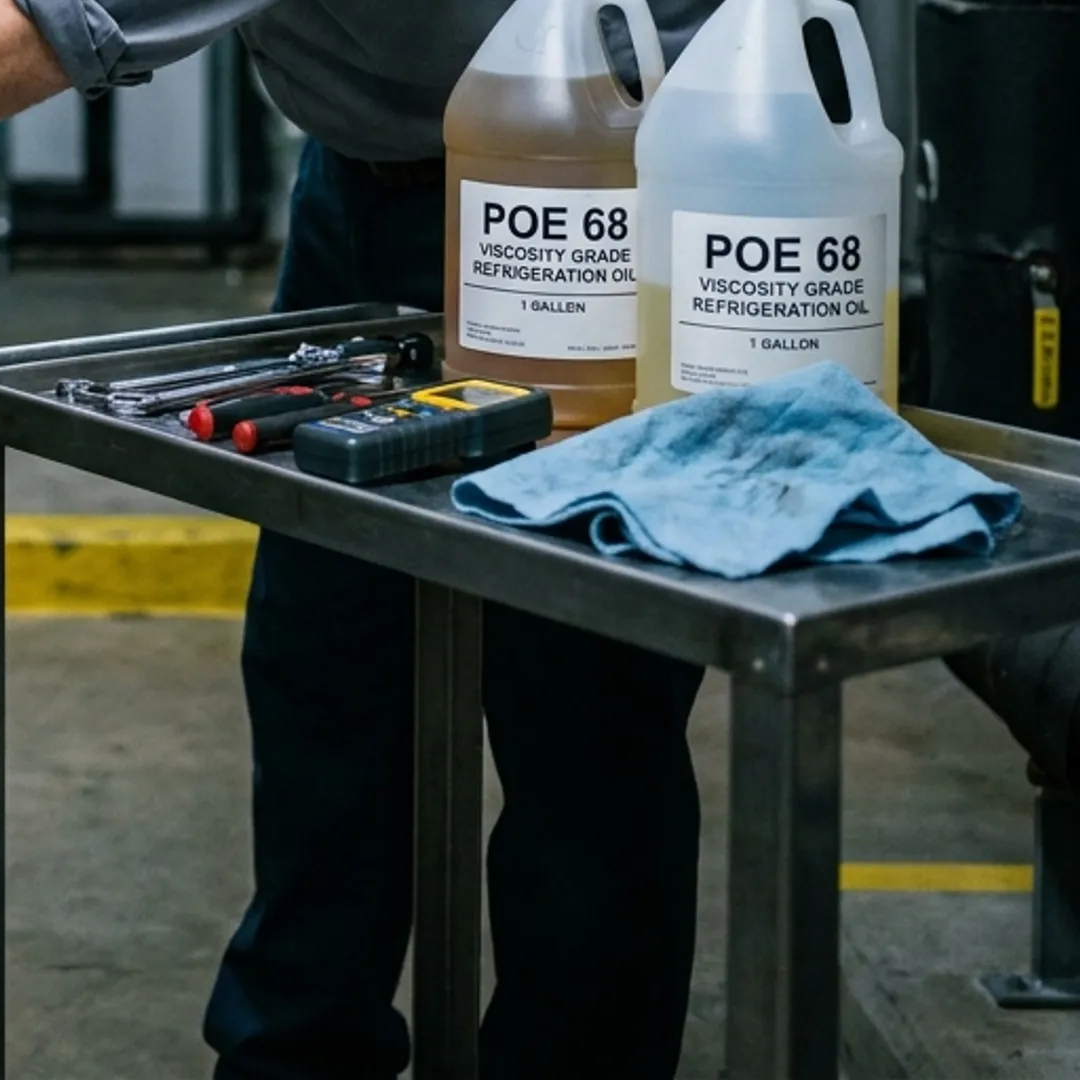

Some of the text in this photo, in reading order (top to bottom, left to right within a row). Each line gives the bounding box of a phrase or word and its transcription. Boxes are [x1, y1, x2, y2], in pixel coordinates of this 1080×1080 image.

[482, 202, 629, 241] POE 68
[480, 243, 631, 264] VISCOSITY GRADE
[705, 234, 861, 273] POE 68
[473, 261, 607, 283] REFRIGERATION
[699, 277, 865, 297] VISCOSITY GRADE
[521, 300, 527, 311] 1
[692, 297, 870, 319] REFRIGERATION OIL
[750, 337, 820, 351] 1 GALLON
